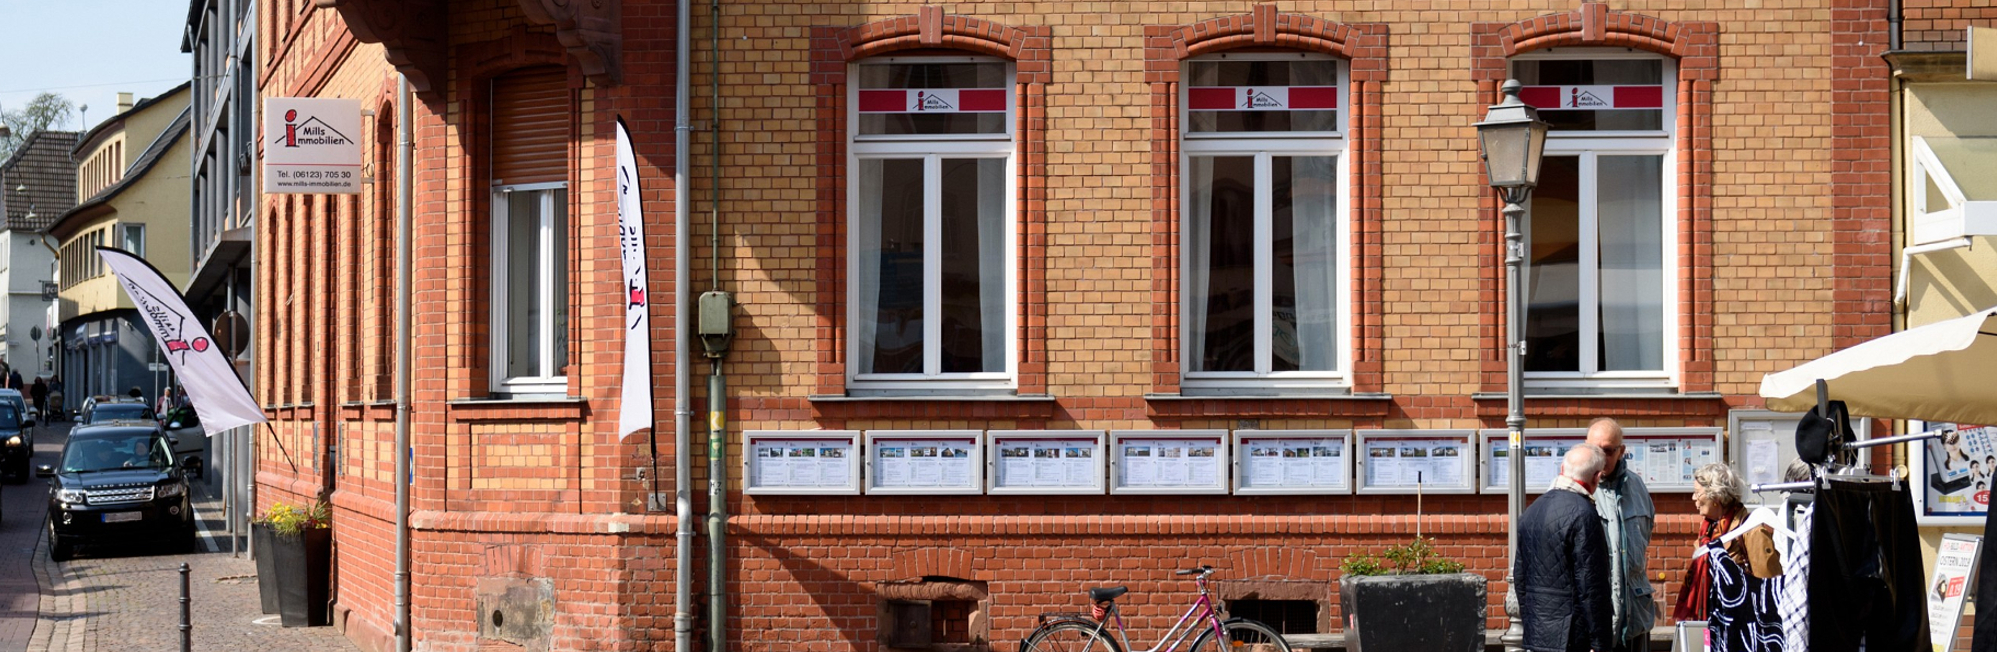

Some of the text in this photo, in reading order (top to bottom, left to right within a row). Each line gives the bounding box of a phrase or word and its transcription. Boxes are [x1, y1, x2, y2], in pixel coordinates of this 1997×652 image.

[303, 127, 325, 136] Mills
[277, 170, 351, 179] Tel. (06123) 705 30
